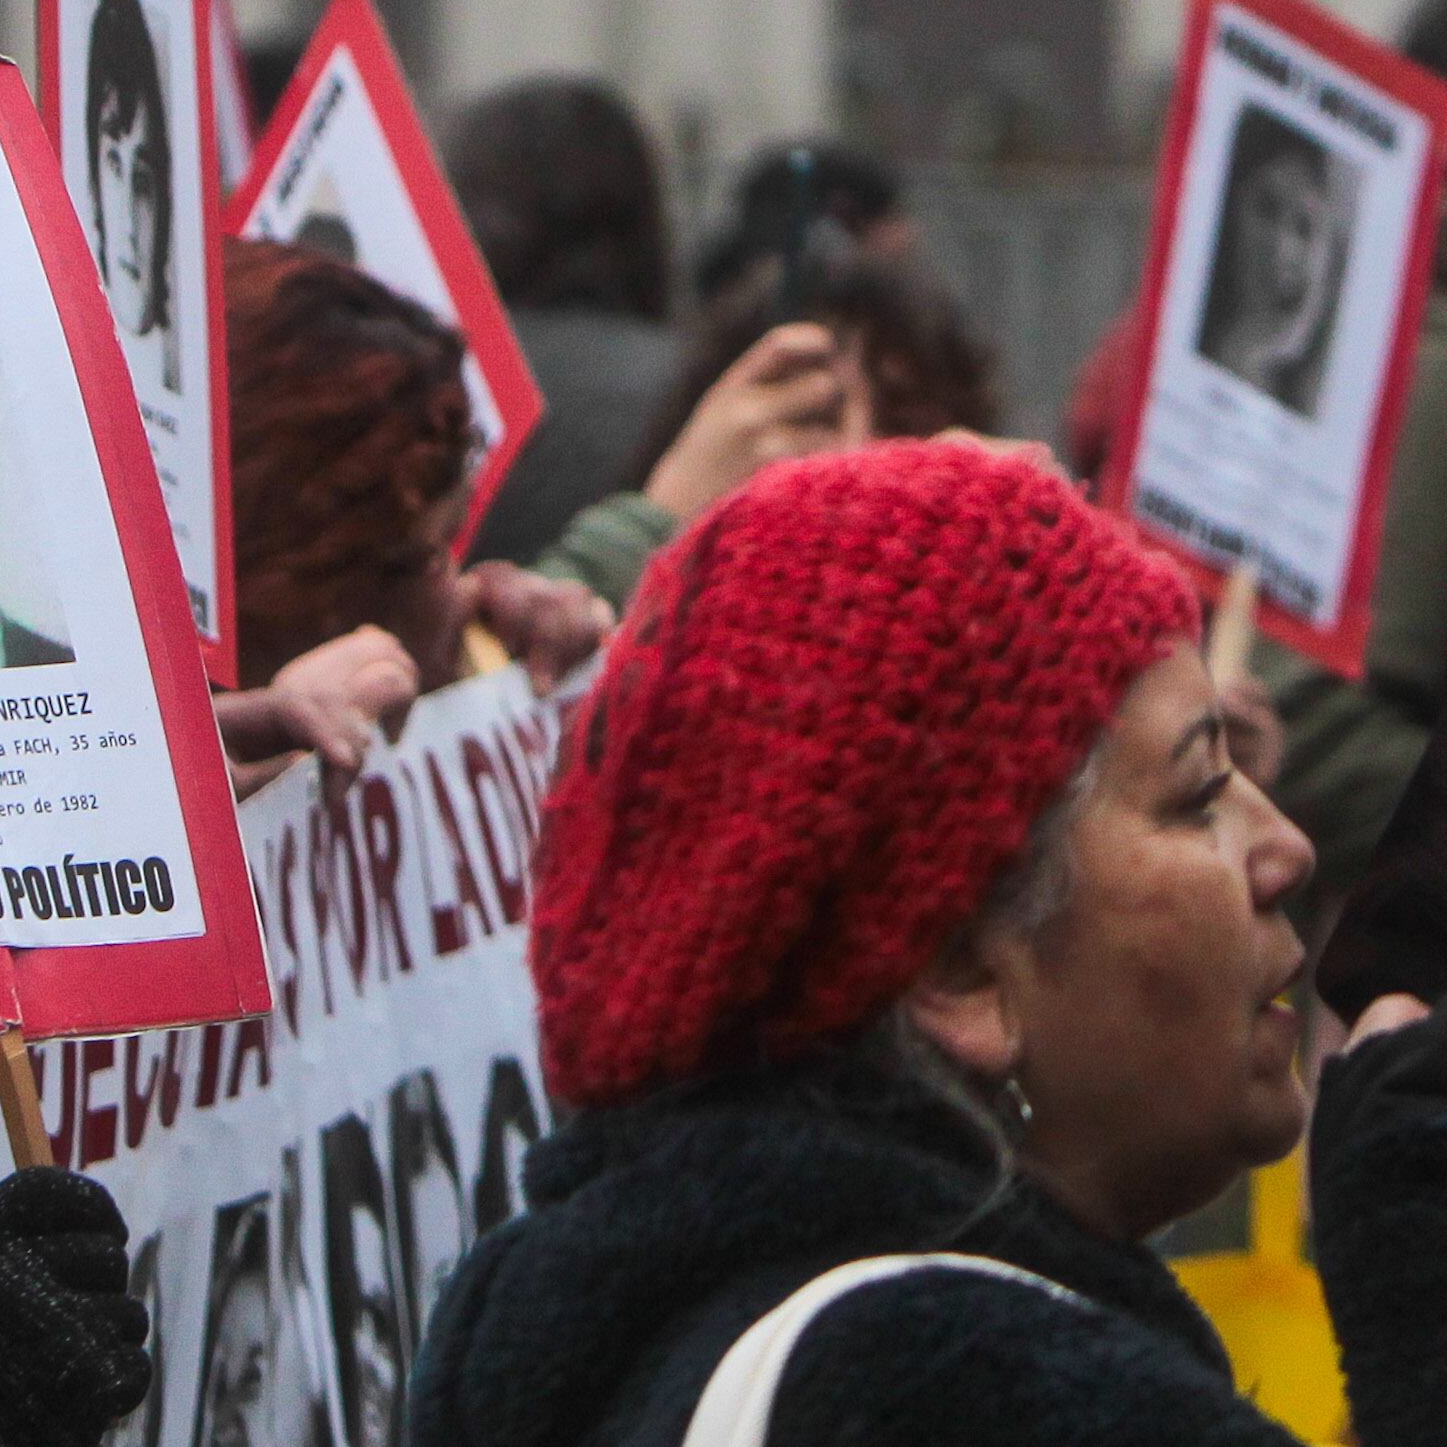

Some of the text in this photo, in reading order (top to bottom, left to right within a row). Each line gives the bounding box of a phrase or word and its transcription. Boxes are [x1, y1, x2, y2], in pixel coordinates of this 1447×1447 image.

[14, 737, 61, 757] FACH,
[70, 734, 90, 752] 35
[99, 730, 138, 749] años
[34, 797, 53, 814] de
[61, 793, 100, 812] 1982
[3, 853, 175, 921] POLÍTICO
